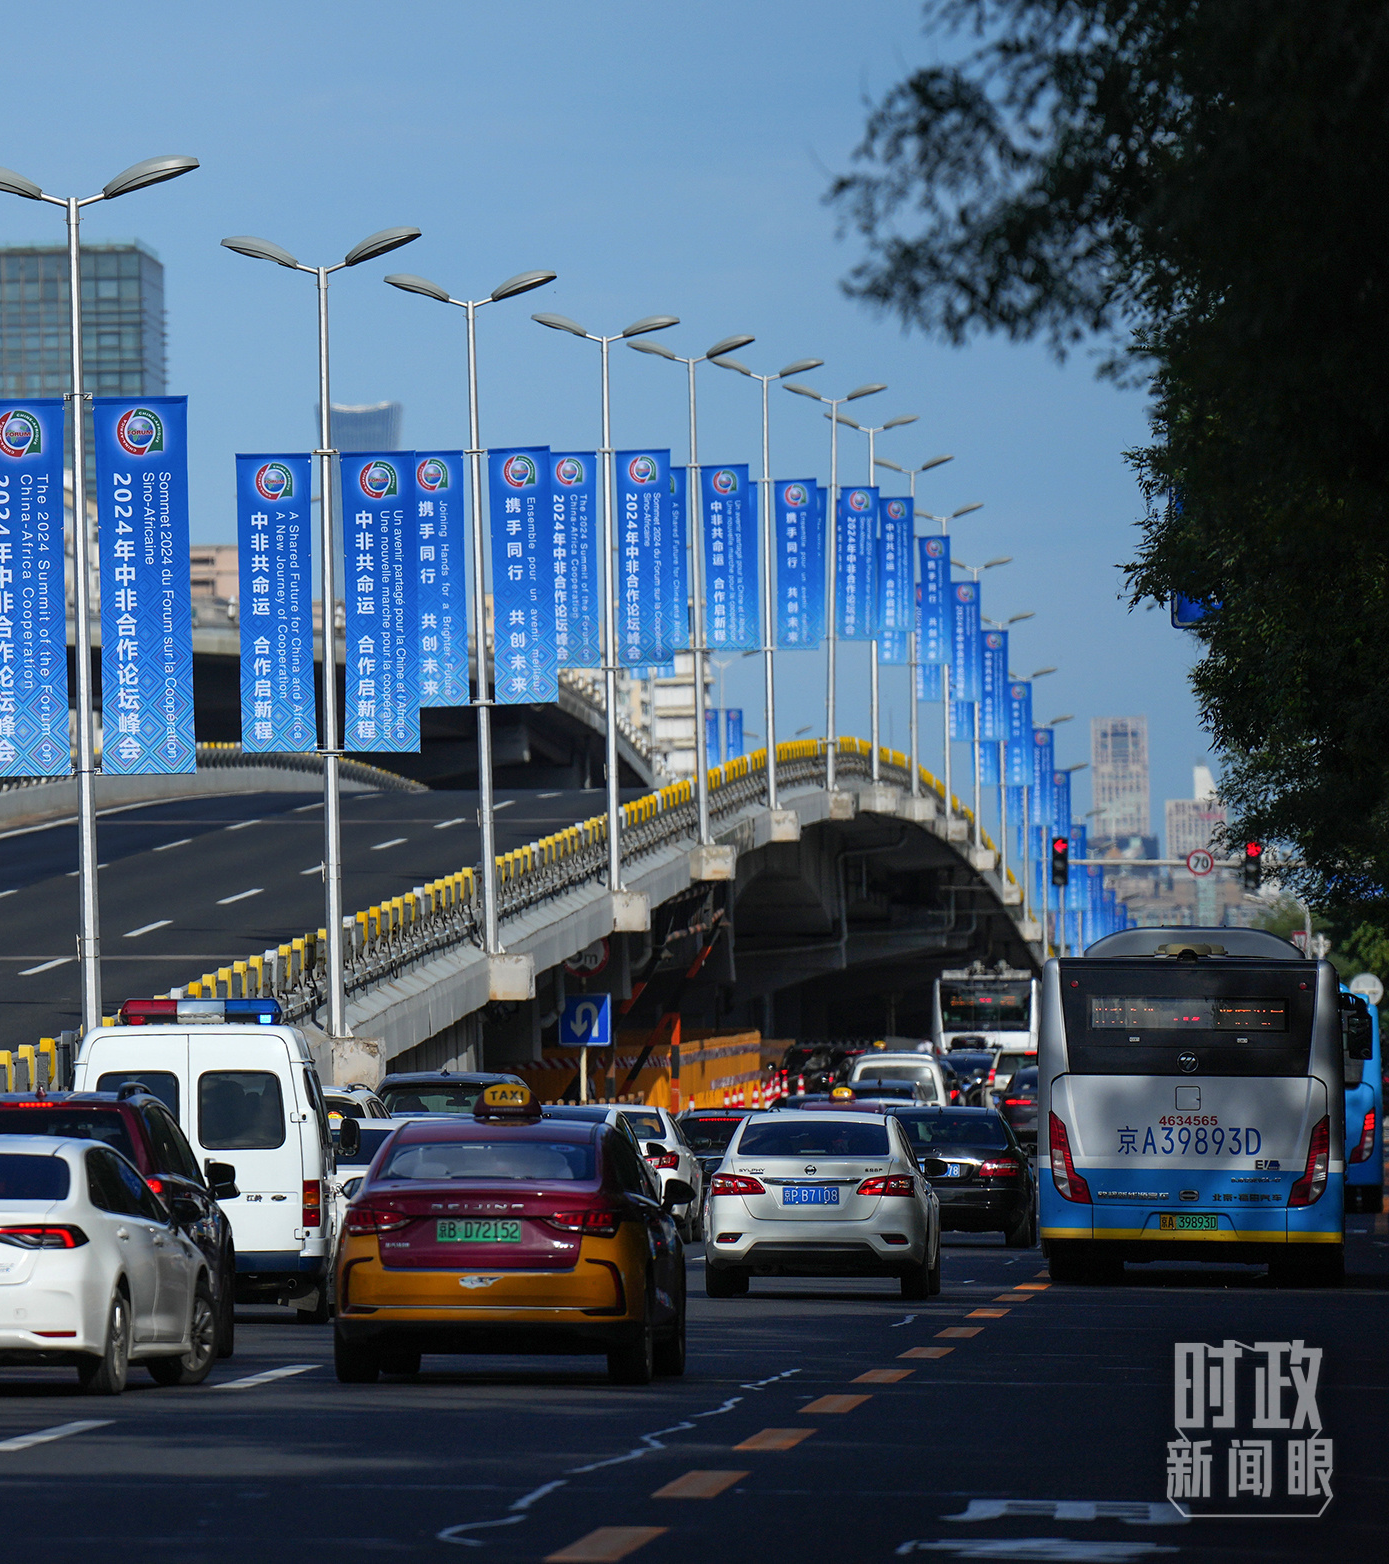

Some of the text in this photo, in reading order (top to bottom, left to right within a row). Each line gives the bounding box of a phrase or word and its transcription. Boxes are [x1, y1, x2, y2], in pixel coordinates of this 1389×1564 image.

[5, 430, 32, 438] FORUM
[143, 473, 155, 564] Sino-Africaine
[394, 511, 403, 525] Un
[439, 501, 447, 536] Joining
[527, 498, 536, 549] Ensemble
[290, 525, 299, 567] Shared
[394, 529, 405, 561] avenir
[441, 544, 449, 576] Hands
[21, 475, 34, 688] China-Africa Cooperation
[393, 565, 403, 605] partagé
[528, 557, 536, 580] pour
[554, 495, 568, 660] 2024年中非合作论坛峰会
[626, 494, 640, 659] 2024年中非合作论坛峰会
[275, 512, 288, 698] A New Journey of Cooperation
[291, 574, 300, 612] Future
[419, 501, 438, 696] 携手同行 共创未来
[442, 583, 450, 596] for
[506, 498, 527, 692] 携手同行 共创未来
[530, 589, 537, 600] un
[37, 474, 52, 761] The 2024 Summit of the Forum on
[114, 473, 141, 759] 2024年中非合作论坛峰会
[159, 472, 178, 758] Sommet 2024 du Forum sur la Coopération
[251, 512, 273, 739] 中非共命运 合作启新程
[291, 617, 301, 633] for
[356, 511, 376, 738] 中非共命运 合作启新程
[381, 511, 393, 740] Une nouvelle marche pour la coopération
[394, 609, 403, 632] pour
[396, 636, 405, 645] la
[441, 617, 451, 656] Brighter
[292, 638, 301, 672] China
[396, 648, 406, 679] Chine
[532, 649, 541, 693] meilleur
[293, 678, 302, 699] and
[397, 683, 405, 692] et
[444, 663, 453, 696] Future
[294, 704, 303, 738] Africa
[1193, 855, 1209, 870] 70
[490, 1090, 524, 1101] TAXI
[1158, 1115, 1218, 1127] 4634565
[1117, 1126, 1262, 1156] 京A39893D
